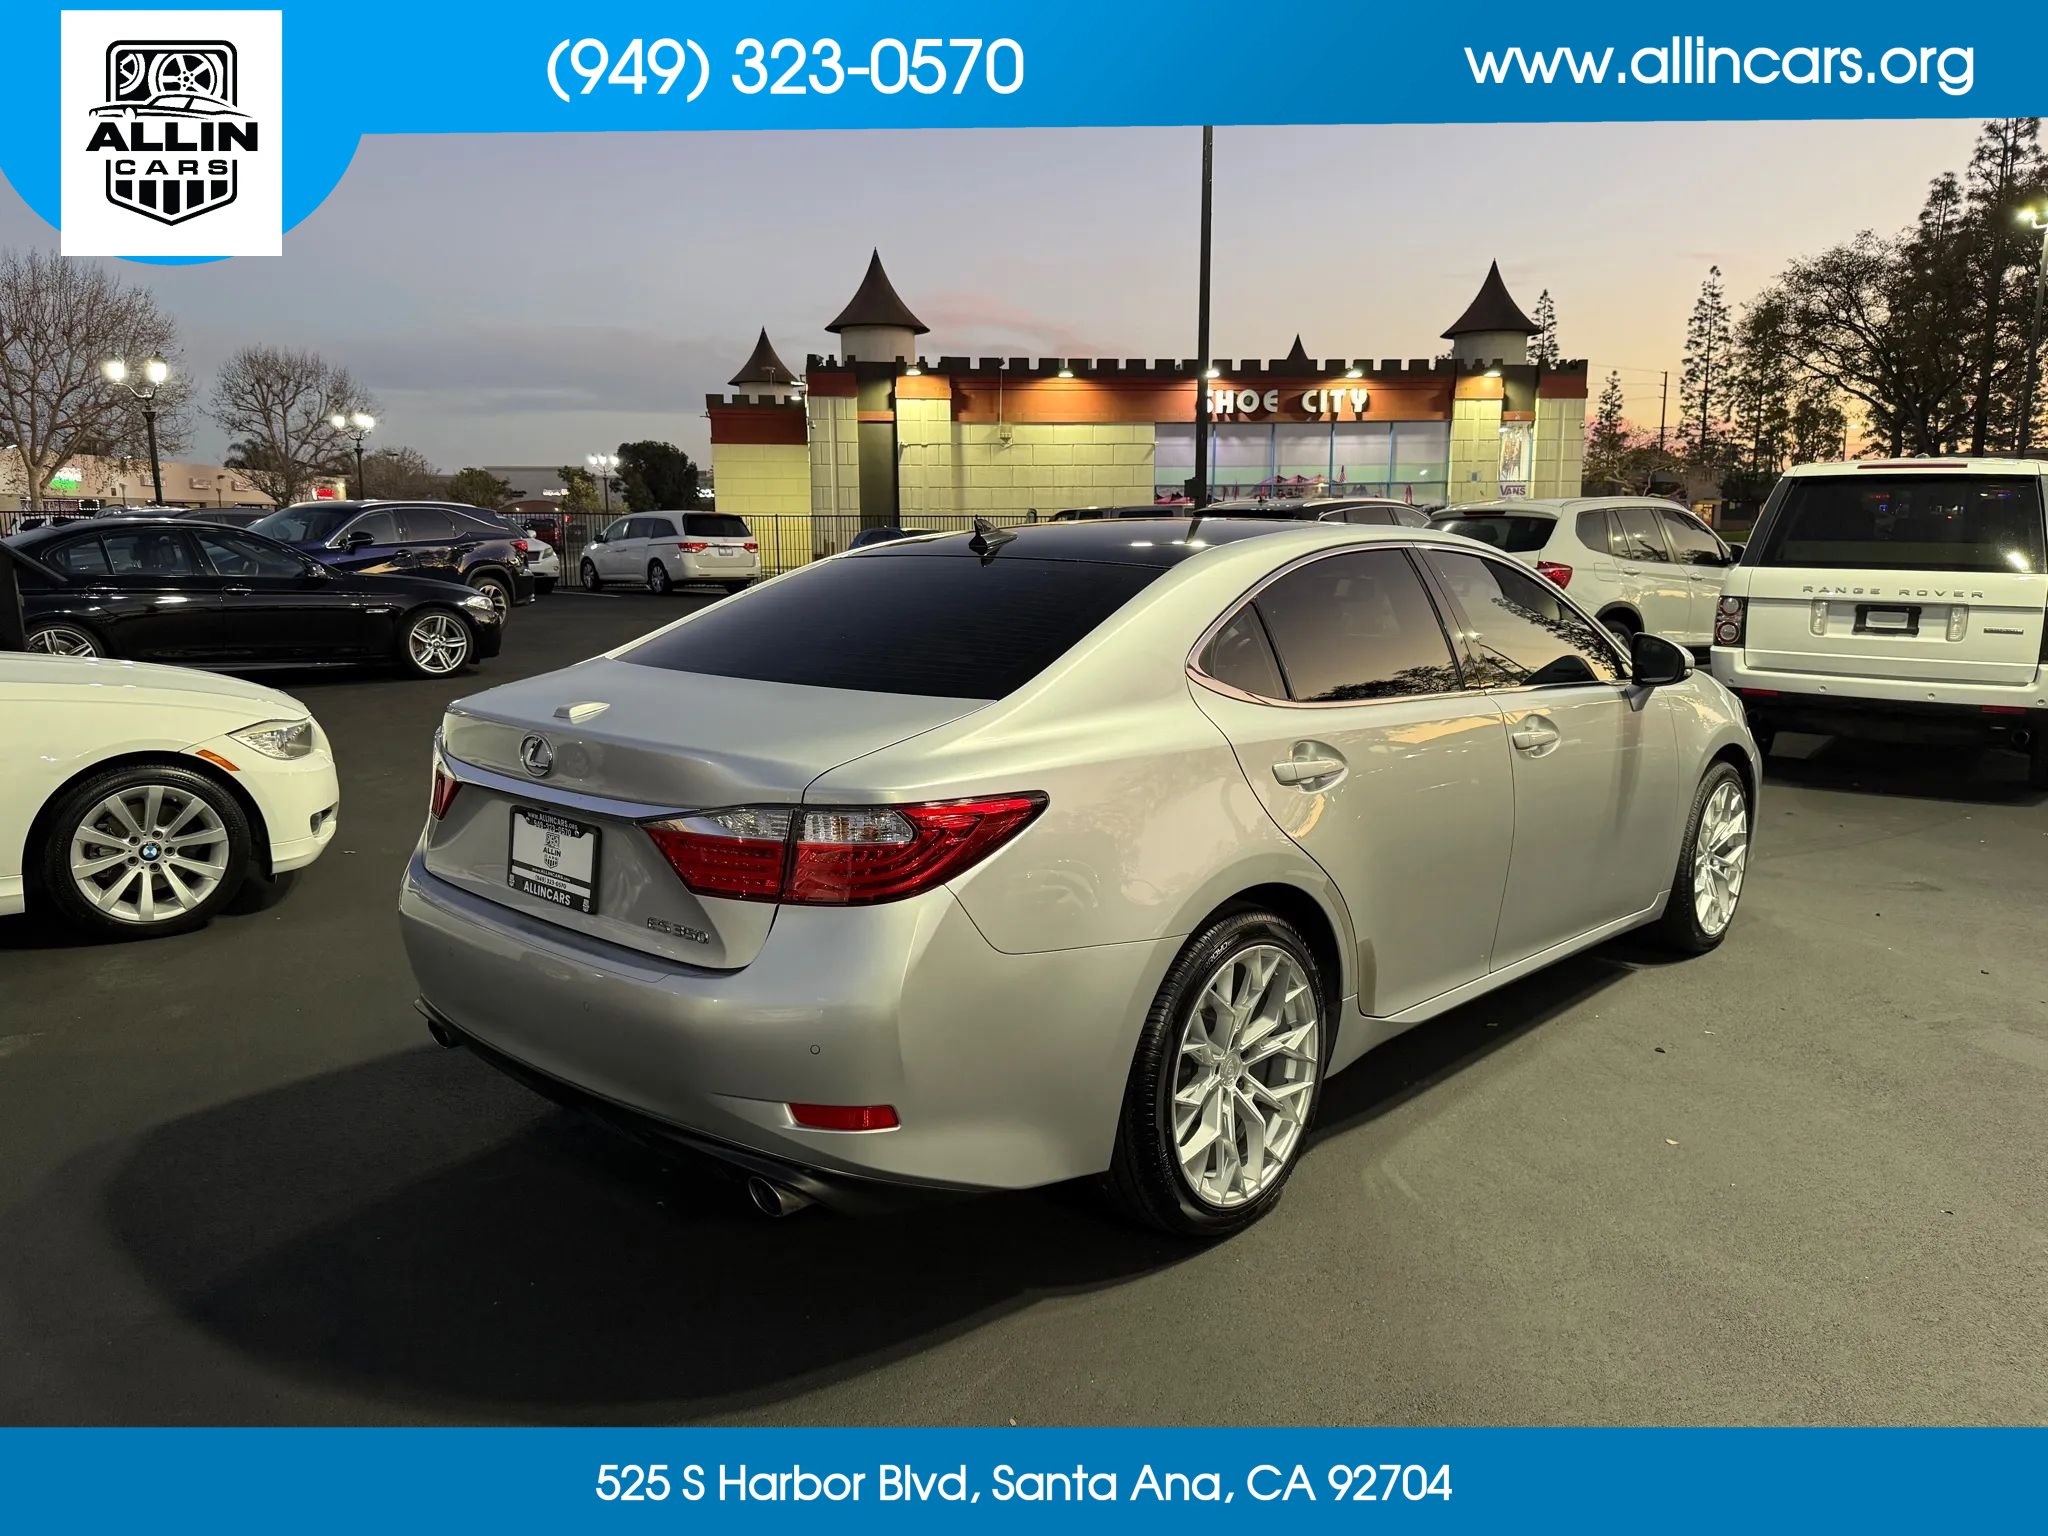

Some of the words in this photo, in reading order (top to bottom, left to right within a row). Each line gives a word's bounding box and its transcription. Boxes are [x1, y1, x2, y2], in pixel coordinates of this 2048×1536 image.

[1302, 388, 1368, 413] CITY
[1803, 585, 1881, 595] RANGE
[1899, 588, 1984, 599] ROVER
[543, 846, 562, 857] ALLIN
[523, 880, 571, 906] ALLINCARS
[648, 917, 671, 933] ES
[673, 923, 710, 944] 350
